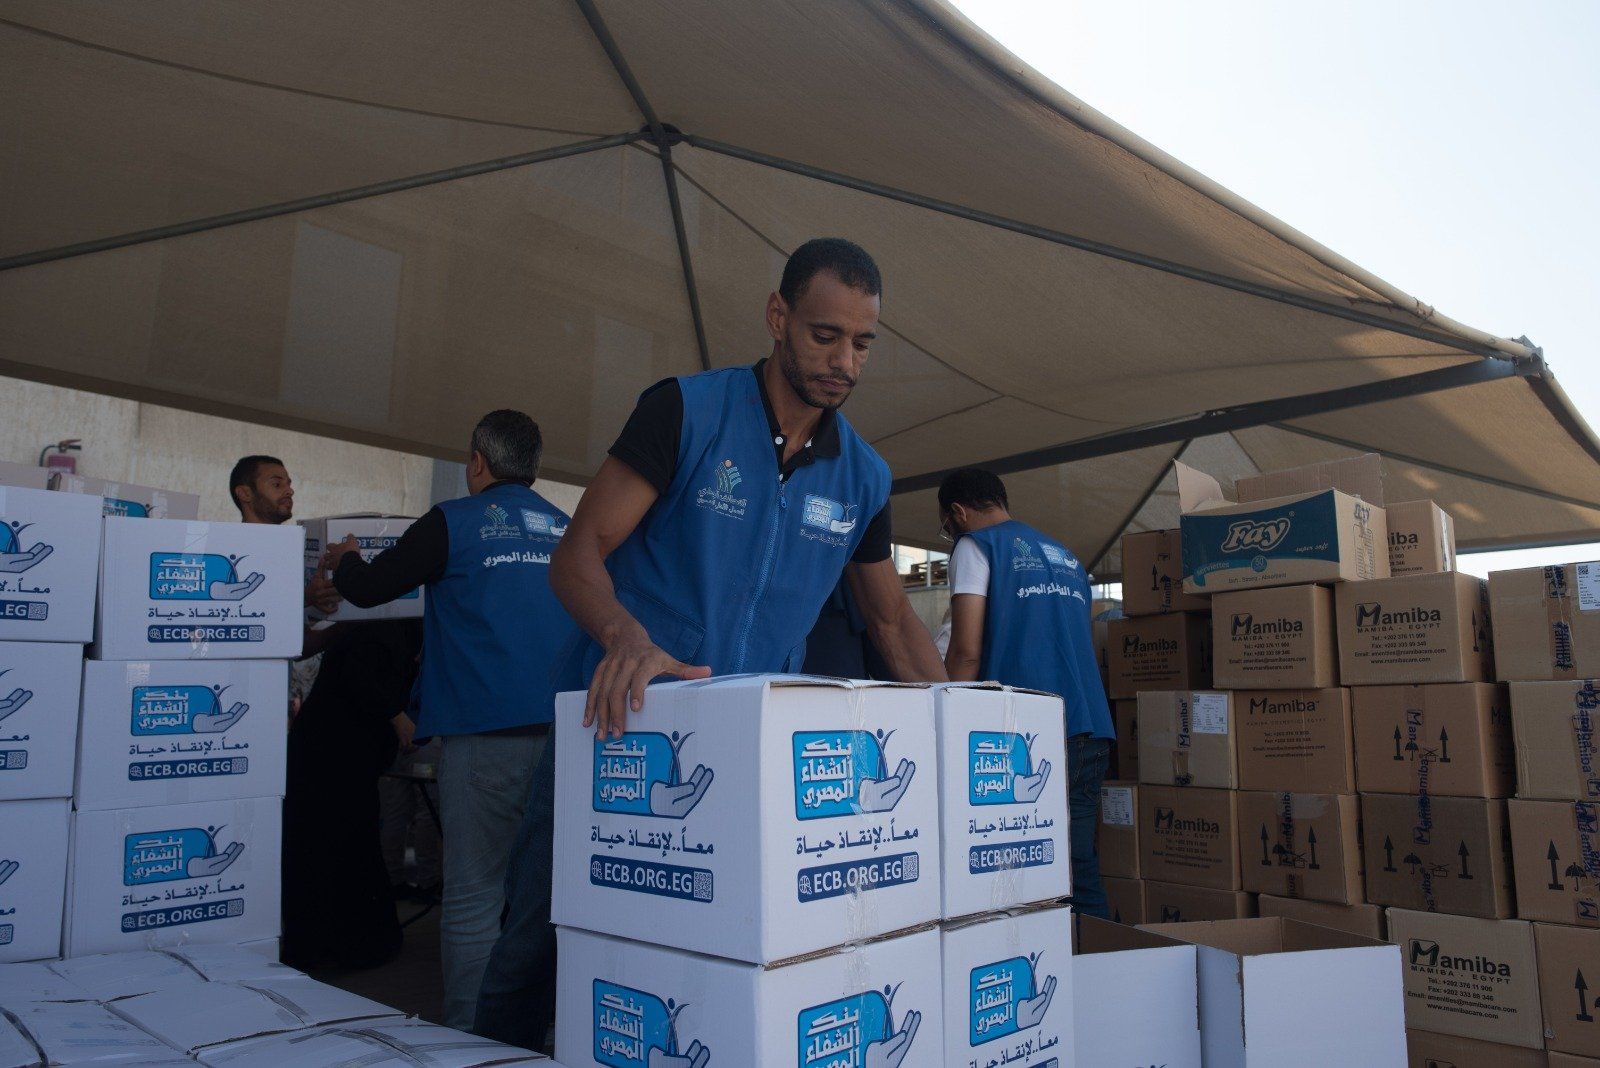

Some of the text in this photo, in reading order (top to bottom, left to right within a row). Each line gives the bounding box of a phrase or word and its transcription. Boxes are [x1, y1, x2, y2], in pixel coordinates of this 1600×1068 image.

[1222, 518, 1290, 553] Fay
[158, 558, 205, 569] بنك
[483, 551, 521, 567] المصري
[157, 567, 205, 581] الشفاء
[157, 580, 205, 594] المصري
[1016, 583, 1046, 598] المصري
[148, 608, 185, 621] حياة
[1355, 602, 1441, 626] Mamiba
[163, 628, 248, 639] ECB.ORG.EG
[1231, 613, 1303, 636] Mamiba
[1123, 636, 1178, 653] Mamiba
[140, 690, 188, 702] بنك
[1250, 697, 1316, 714] Mamiba
[139, 701, 188, 715] الشفاء
[139, 713, 187, 730] المصري
[1178, 702, 1192, 748] Mamiba
[129, 744, 166, 757] حياة
[601, 740, 646, 757] بنك
[802, 738, 852, 758] بنك
[975, 740, 1010, 756] بنك
[145, 761, 231, 777] ECB.ORG.EG
[600, 757, 646, 779] الشفاء
[801, 757, 853, 783] الشفاء
[974, 755, 1011, 774] الشفاء
[600, 780, 645, 803] المصري
[803, 779, 853, 808] المصري
[974, 775, 1010, 797] المصري
[969, 818, 996, 838] حياة
[1154, 807, 1219, 833] Mamiba
[133, 836, 182, 849] بنك
[591, 826, 625, 849] حياة
[797, 835, 835, 858] حياة
[132, 847, 182, 864] الشفاء
[981, 845, 1042, 867] ECB.ORG.EG
[132, 859, 182, 879] المصري
[604, 863, 692, 893] ECB.ORG.EG
[814, 860, 902, 893] ECB.ORG.EG
[122, 895, 161, 906] حياة
[138, 904, 226, 927] ECB.ORG.EG
[1409, 939, 1511, 977] Mamiba
[976, 969, 1012, 991] بنك
[1410, 965, 1454, 977] MAMIBA
[1472, 974, 1511, 984] EGYPT
[975, 985, 1012, 1013] الشفاء
[1408, 991, 1427, 1000] Email:
[600, 994, 643, 1020] بنك
[1426, 1004, 1499, 1019] www.mamibacare.com
[600, 1009, 643, 1042] الشفاء
[807, 1006, 859, 1036] بنك
[976, 1004, 1012, 1035] المصري
[600, 1036, 643, 1061] المصري
[806, 1025, 859, 1064] الشفاء
